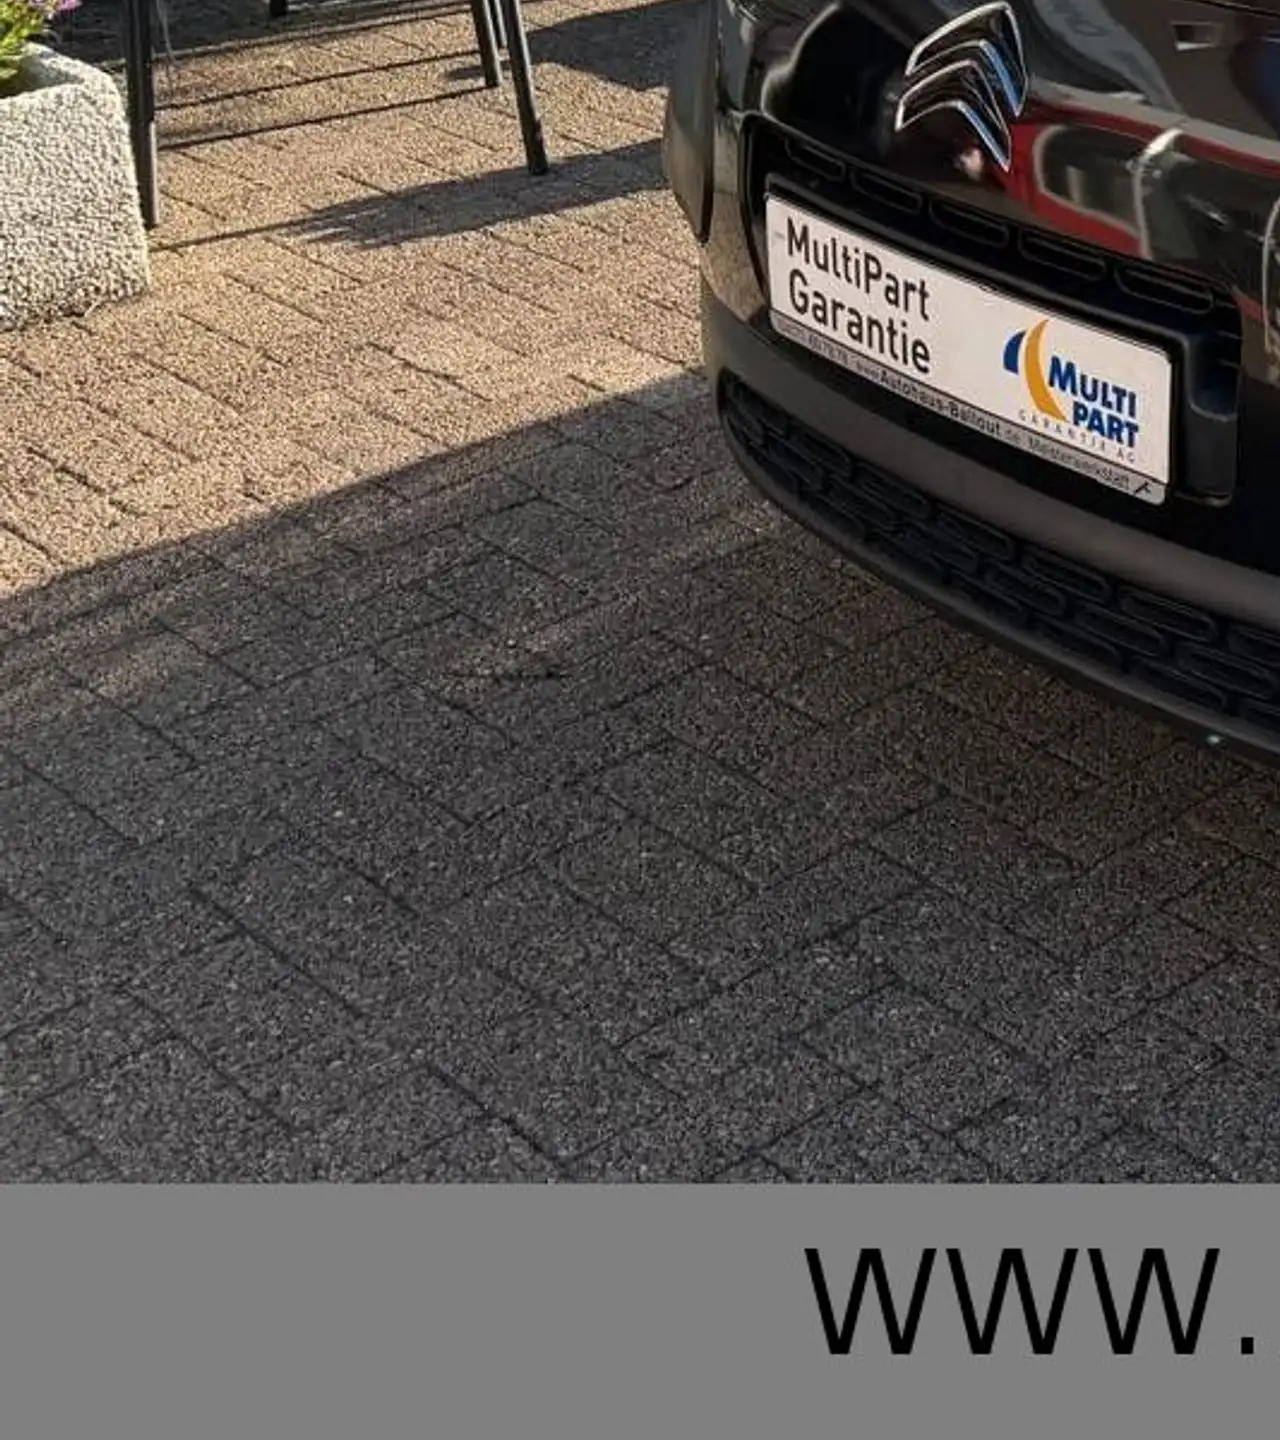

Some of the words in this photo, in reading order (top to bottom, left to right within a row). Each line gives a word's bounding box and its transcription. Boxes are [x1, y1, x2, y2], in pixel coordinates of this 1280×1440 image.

[787, 215, 931, 322] MultiPart
[789, 268, 931, 374] Garantie
[1049, 354, 1137, 418] MULTI
[1018, 408, 1106, 452] GARANTIE
[1072, 400, 1140, 449] PART
